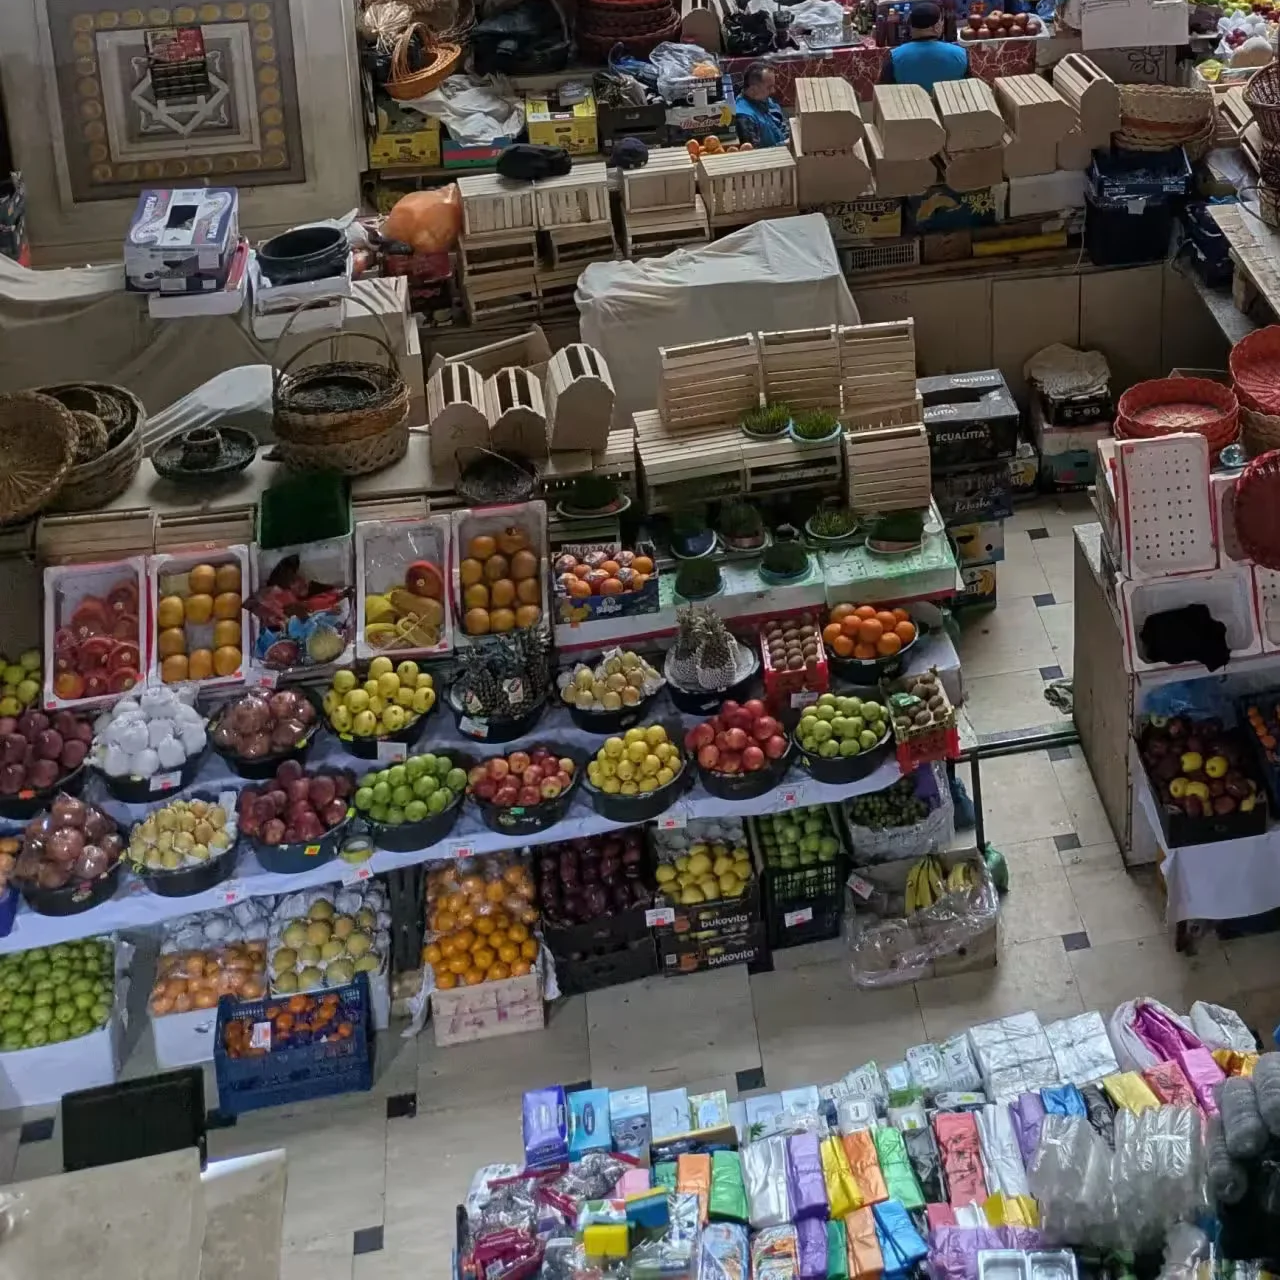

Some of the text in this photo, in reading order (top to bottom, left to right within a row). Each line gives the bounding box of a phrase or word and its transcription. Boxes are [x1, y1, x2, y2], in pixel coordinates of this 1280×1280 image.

[935, 429, 985, 442] ECUALITTA
[700, 913, 748, 929] bukovita
[707, 950, 755, 966] bukovita
